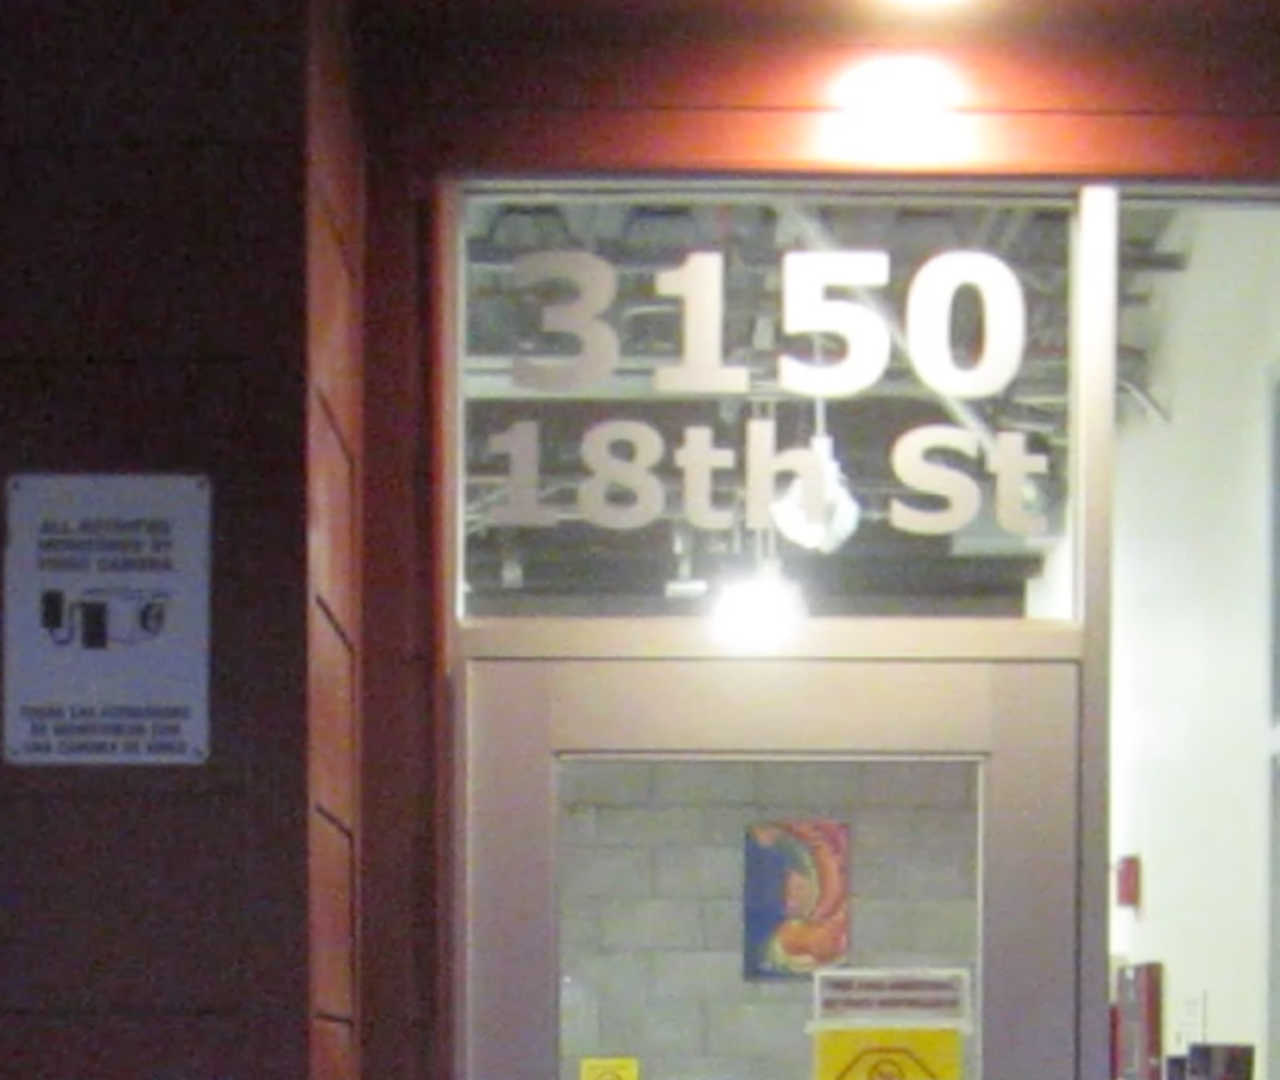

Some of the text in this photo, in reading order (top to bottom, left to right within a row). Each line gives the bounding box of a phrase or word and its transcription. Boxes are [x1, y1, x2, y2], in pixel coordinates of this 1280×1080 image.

[513, 249, 1026, 398] 3150
[486, 419, 1049, 535] 18th St
